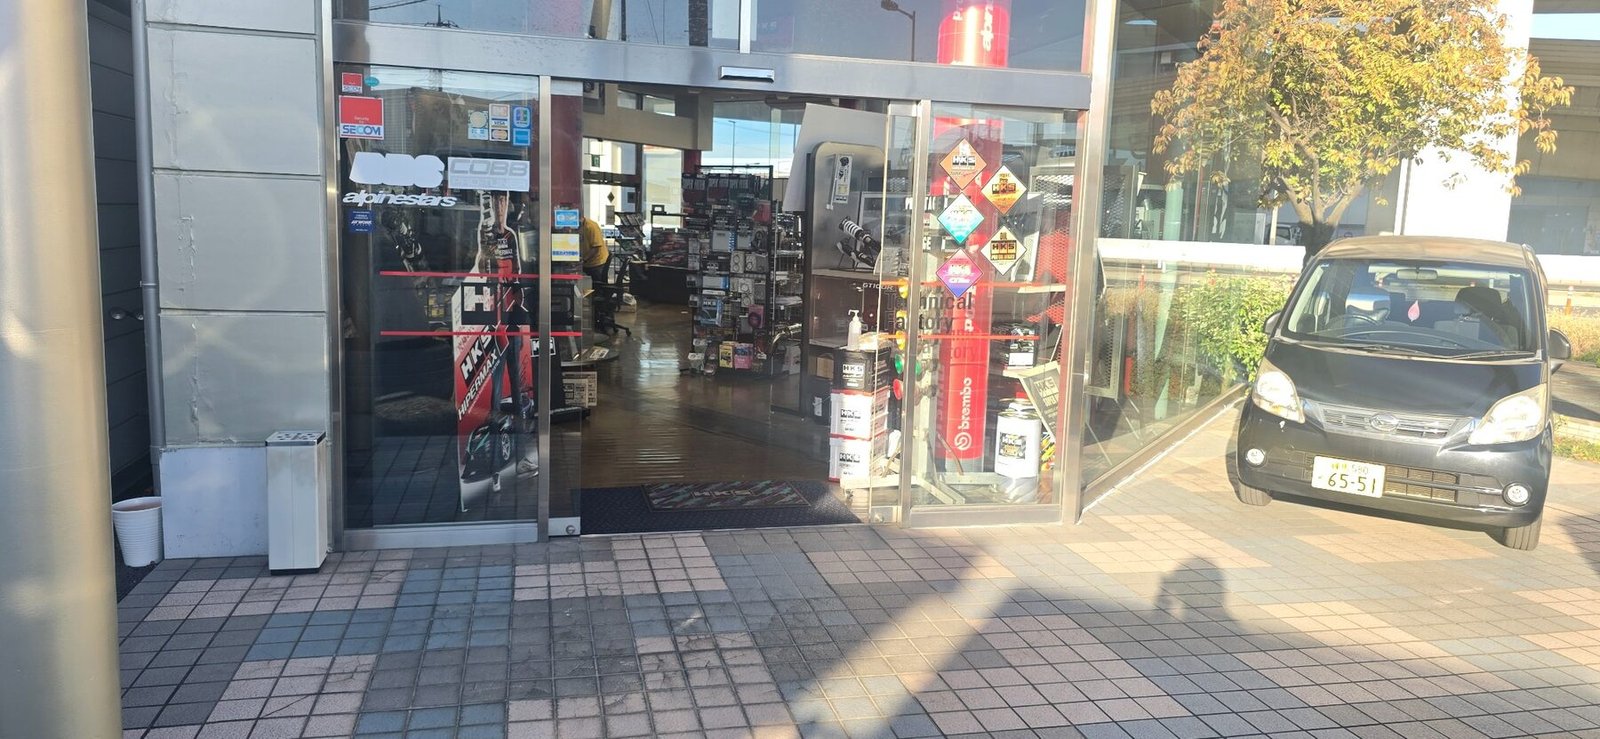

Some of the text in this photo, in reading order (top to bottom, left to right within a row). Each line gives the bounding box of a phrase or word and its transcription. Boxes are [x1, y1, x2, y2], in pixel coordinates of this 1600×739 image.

[342, 124, 381, 136] SECOM
[450, 159, 528, 176] COBB
[952, 155, 976, 166] HKS
[993, 183, 1016, 194] HKS
[342, 189, 457, 207] alpinestars
[992, 243, 1015, 251] HKS
[461, 325, 492, 380] HKS
[458, 348, 498, 420] HIPERMAX
[958, 377, 972, 430] brembo
[1328, 472, 1376, 493] 65-51
